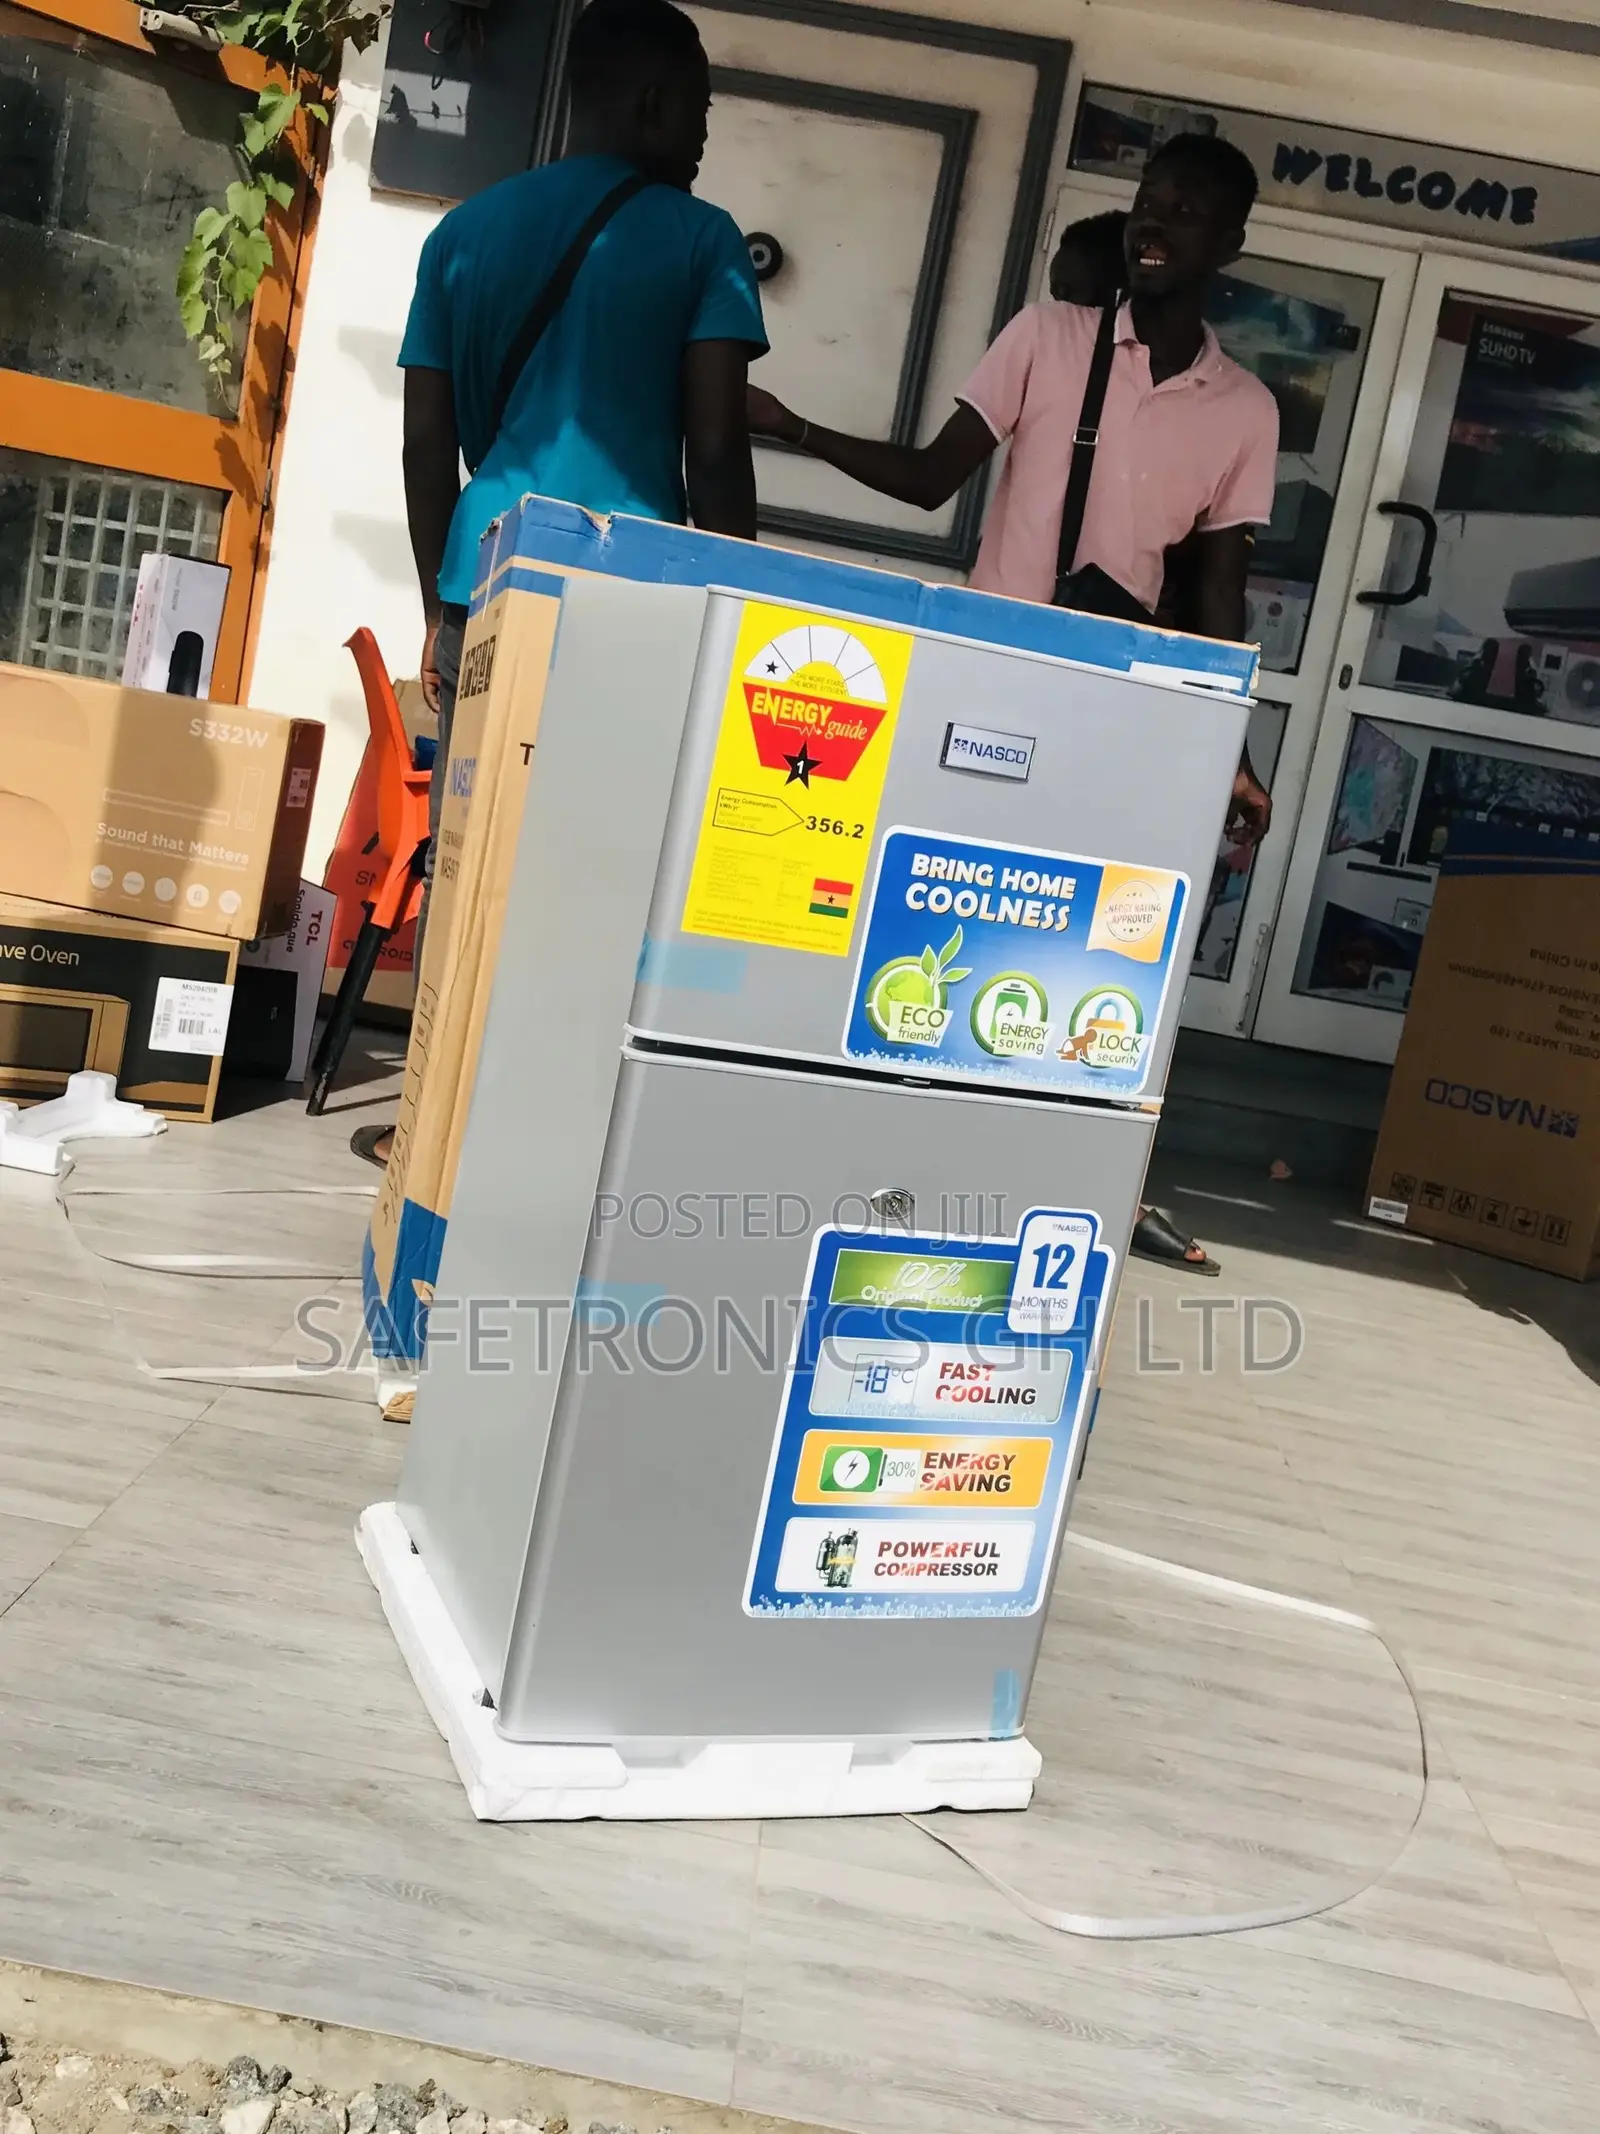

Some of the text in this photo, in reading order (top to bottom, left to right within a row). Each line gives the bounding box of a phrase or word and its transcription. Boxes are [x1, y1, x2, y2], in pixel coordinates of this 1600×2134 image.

[1271, 142, 1539, 225] WELCOME
[751, 687, 868, 740] ENERGY guide
[189, 717, 269, 749] S332W
[520, 743, 535, 766] T
[969, 741, 1027, 765] NASCO
[797, 760, 805, 774] 1
[806, 816, 865, 839] 356.2
[97, 822, 148, 845] Sound
[152, 834, 184, 852] that
[189, 840, 249, 866] Matters
[910, 853, 1077, 901] BRING HOME
[904, 882, 1072, 932] COOLNESS
[306, 910, 323, 946] TCL
[1111, 914, 1153, 925] APPROVED
[30, 944, 80, 966] Oven
[900, 1006, 945, 1029] ECO
[897, 1026, 941, 1045] friendly
[1000, 1022, 1049, 1040] ENERGY
[998, 1039, 1045, 1055] saving
[1099, 1033, 1142, 1053] LOCK
[1096, 1052, 1140, 1067] security
[1425, 1077, 1547, 1129] NASCO
[1057, 1224, 1089, 1233] NASCO
[895, 1261, 967, 1290] 100%
[1033, 1243, 1075, 1290] 12
[929, 1292, 983, 1307] Product
[1020, 1296, 1068, 1310] MONTHS
[1019, 1311, 1066, 1322] WARRANTY
[938, 1361, 997, 1381] FAST
[935, 1384, 1037, 1406] COOLING
[887, 1461, 916, 1478] 30%
[923, 1451, 1017, 1471] ENERGY
[920, 1472, 1012, 1493] SAVING
[877, 1540, 1000, 1559] POWERFUL
[874, 1562, 999, 1578] COMPRESSOR
